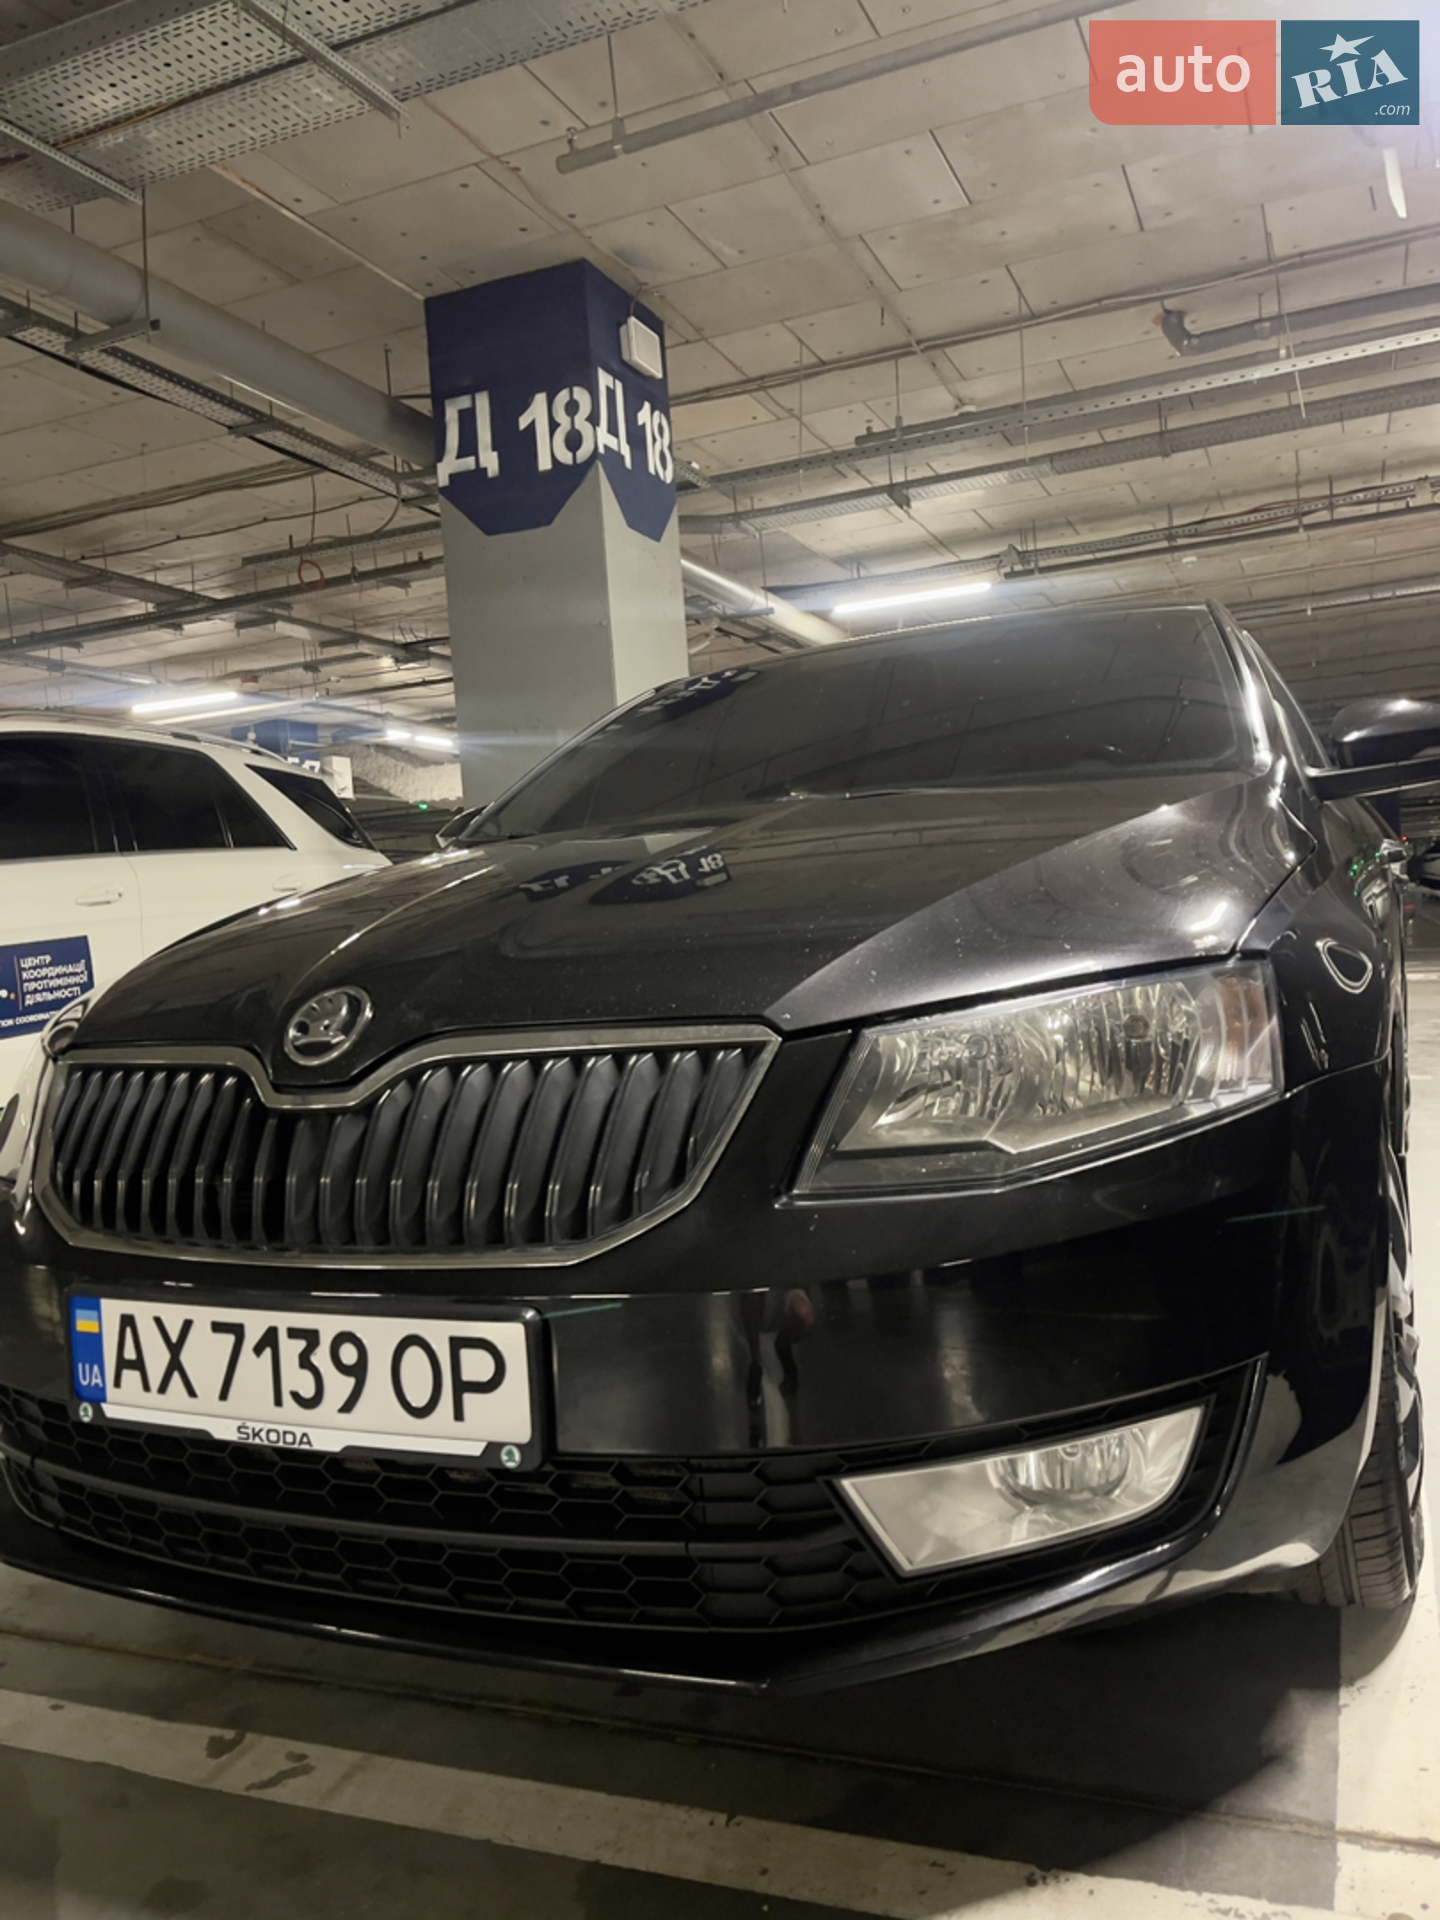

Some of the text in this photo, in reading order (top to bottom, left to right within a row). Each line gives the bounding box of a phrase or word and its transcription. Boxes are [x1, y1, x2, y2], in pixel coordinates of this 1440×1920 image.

[436, 386, 596, 488] Д 18
[595, 366, 674, 484] Д 18
[20, 955, 52, 969] ЦЕНТР
[25, 986, 81, 1006] ДІЯЛЬНОСТІ
[78, 1362, 104, 1388] UA
[113, 1313, 507, 1422] AX 7139 OP
[236, 1422, 314, 1448] ŠKODA
